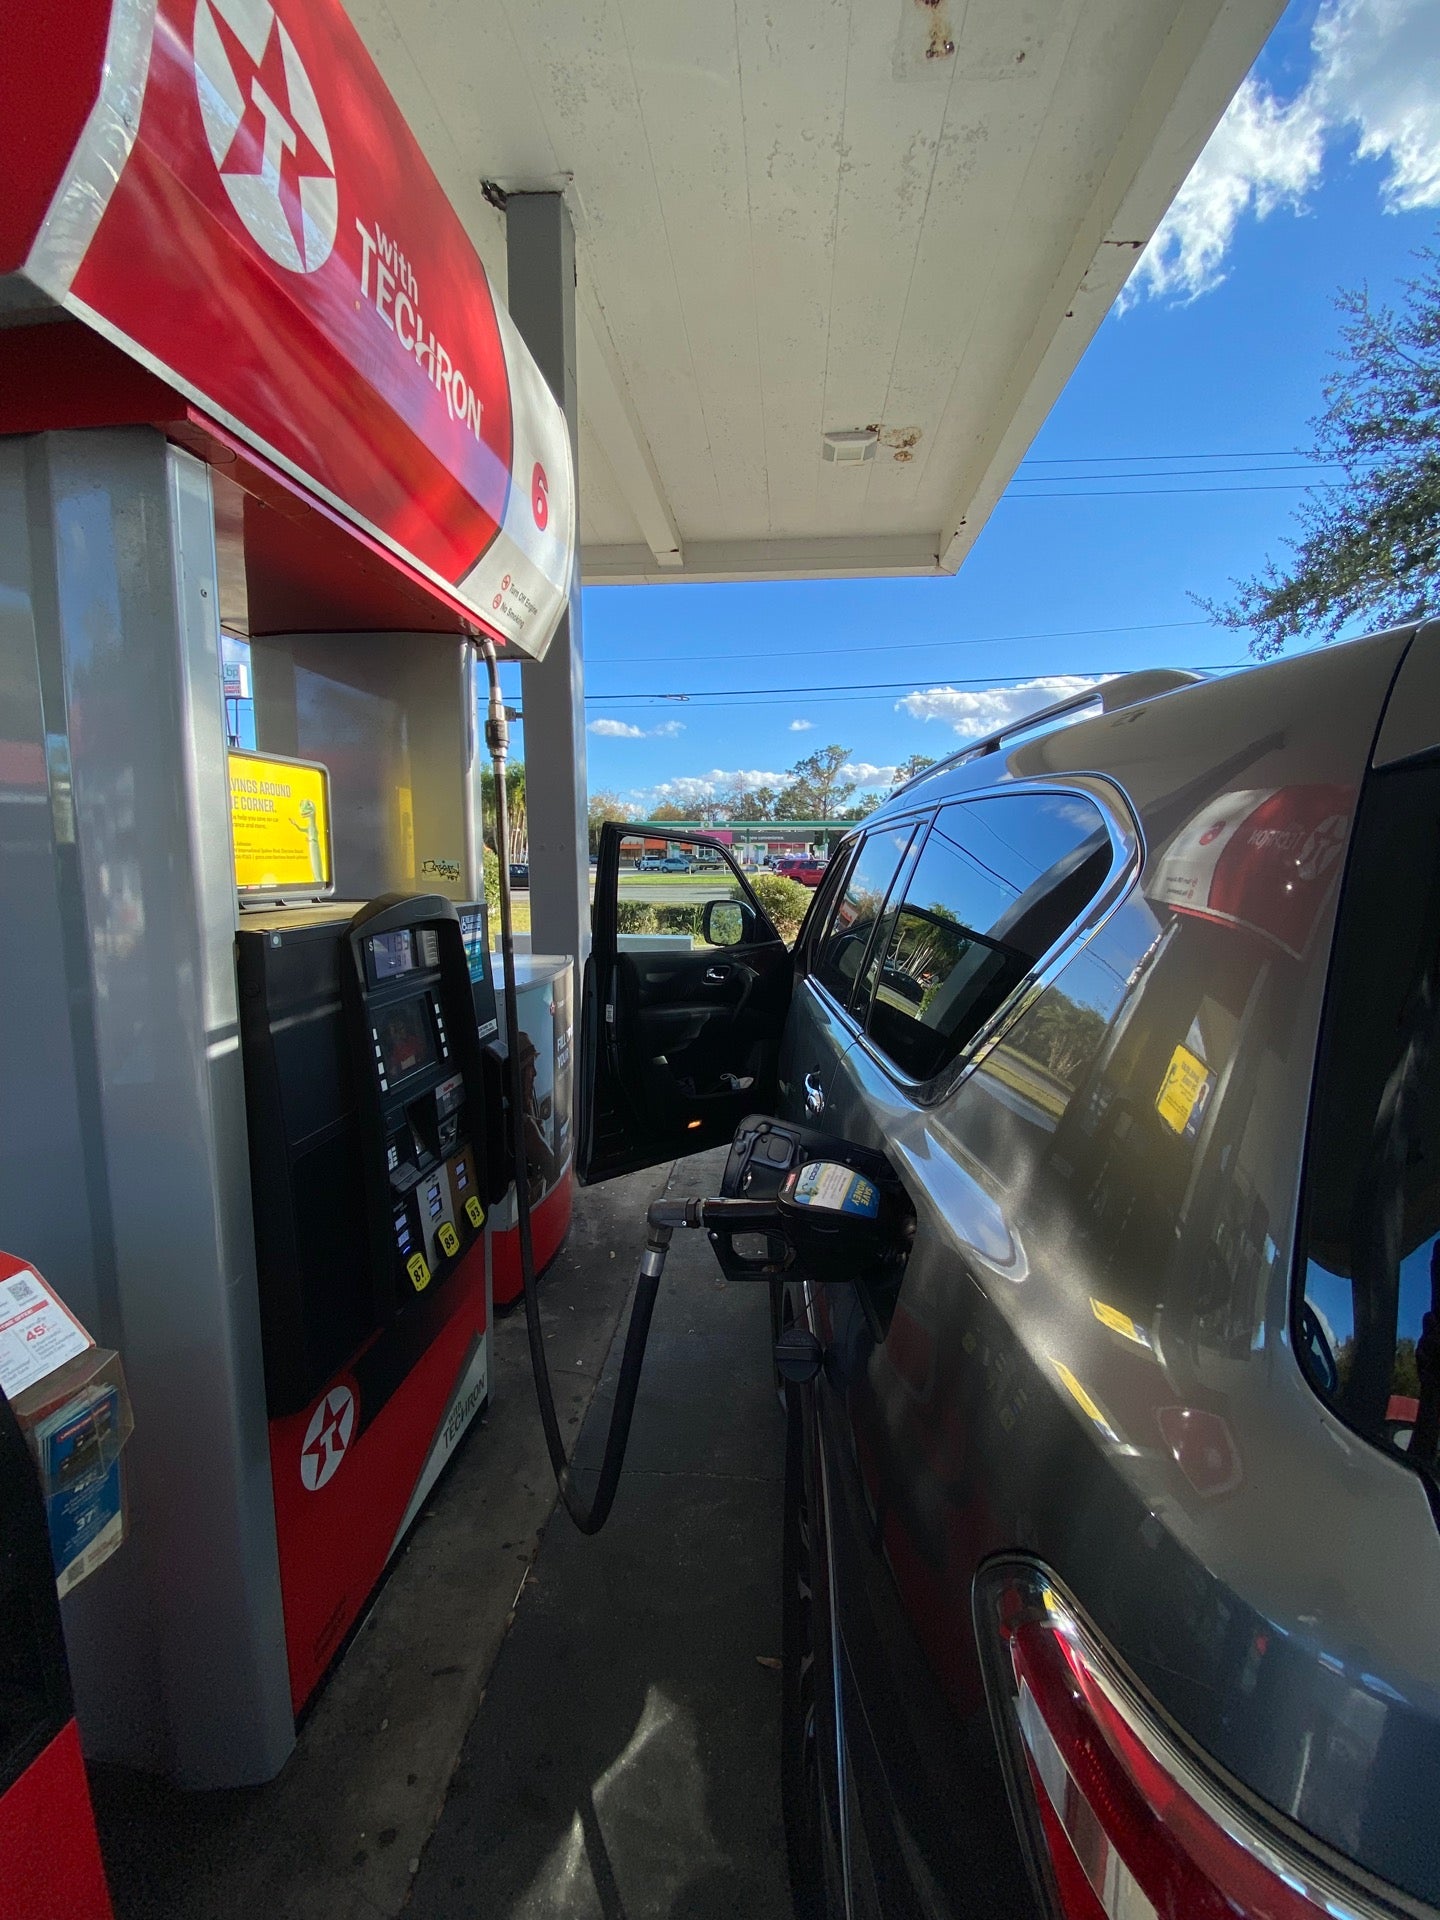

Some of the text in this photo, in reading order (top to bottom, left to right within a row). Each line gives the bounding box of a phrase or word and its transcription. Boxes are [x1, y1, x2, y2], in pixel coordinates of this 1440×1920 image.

[375, 222, 419, 306] with
[355, 217, 482, 442] TECHRON
[532, 462, 549, 531] 6
[509, 583, 538, 616] Turn Off Engine
[500, 602, 525, 630] No Smoking
[230, 778, 291, 798] VINGS AROUND
[241, 796, 277, 813] CORNER.
[861, 1186, 874, 1207] SAVE
[470, 1206, 481, 1220] 93
[444, 1234, 455, 1250] 89
[413, 1264, 425, 1283] 87
[443, 1372, 486, 1448] TECHRON
